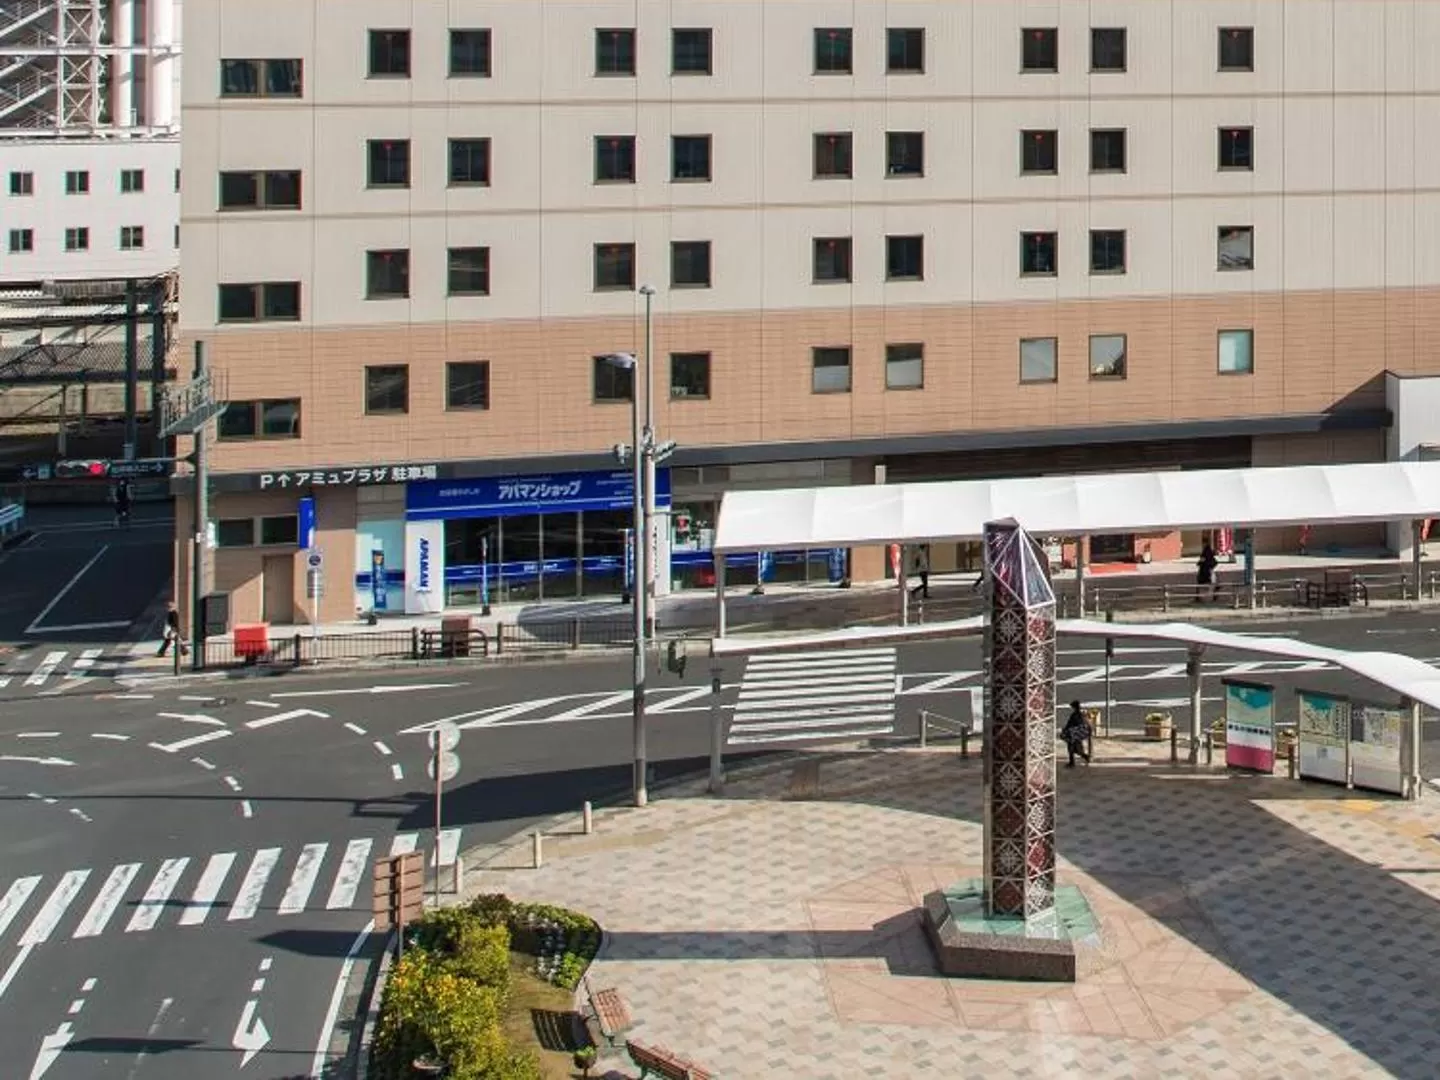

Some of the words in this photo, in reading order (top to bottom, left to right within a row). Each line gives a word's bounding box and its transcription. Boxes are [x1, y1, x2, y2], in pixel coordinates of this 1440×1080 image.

[260, 474, 274, 489] P
[295, 469, 386, 487] アミュプラザ
[499, 480, 582, 500] アパマンショップ
